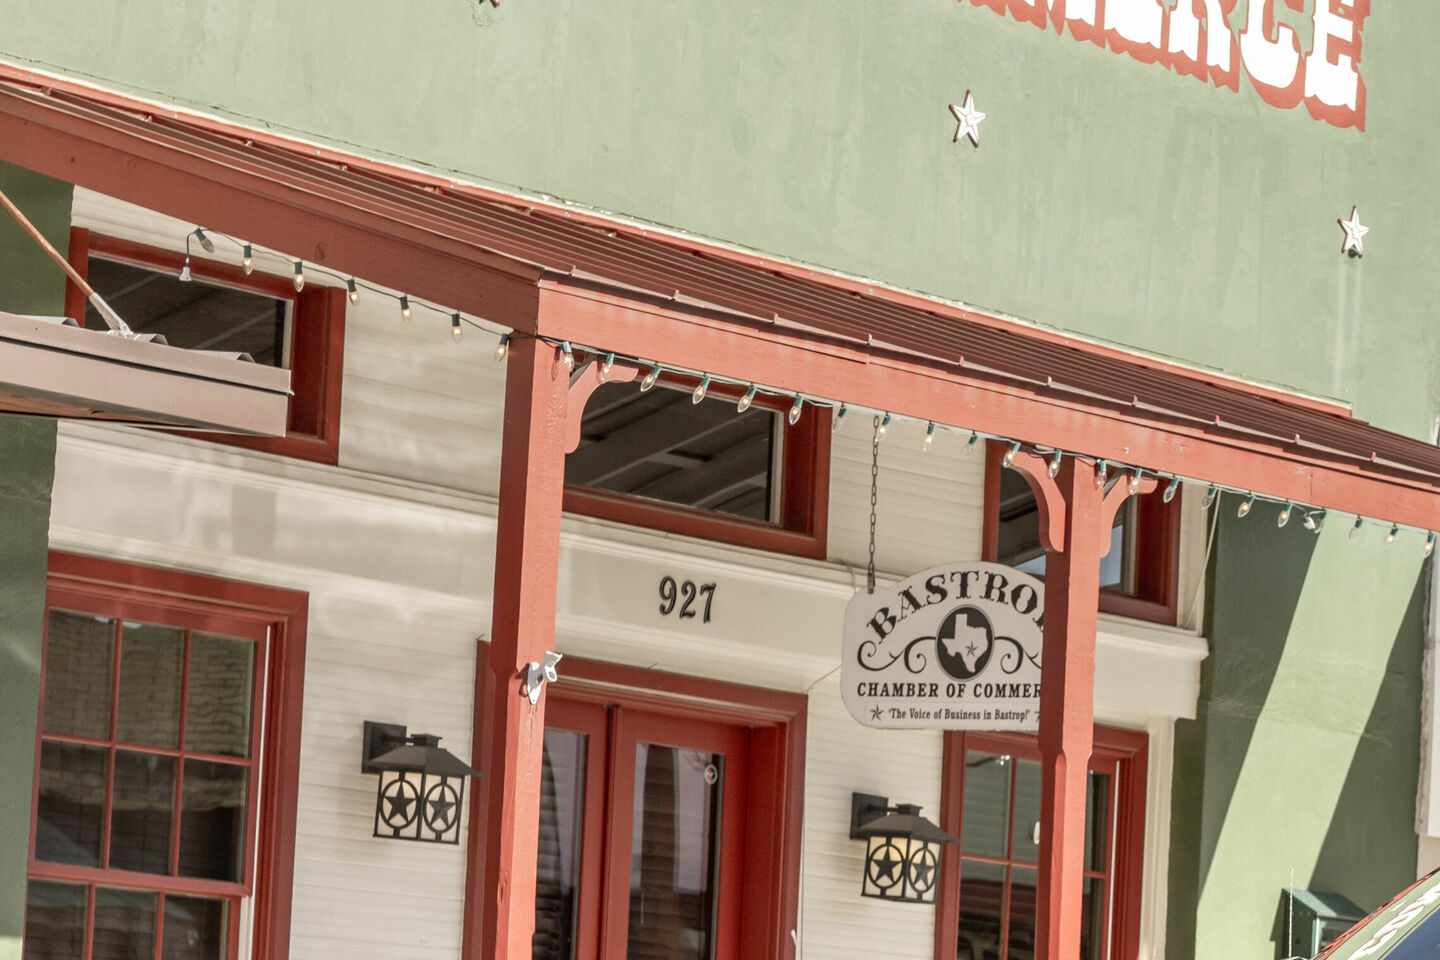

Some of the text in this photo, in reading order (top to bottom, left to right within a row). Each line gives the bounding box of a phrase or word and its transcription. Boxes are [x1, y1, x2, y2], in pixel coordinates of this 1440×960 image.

[658, 575, 717, 623] 927
[857, 682, 1041, 698] CHAMBER OF COMMER
[909, 708, 930, 719] Voice
[933, 708, 942, 719] of
[944, 708, 980, 720] Business
[983, 709, 991, 720] in
